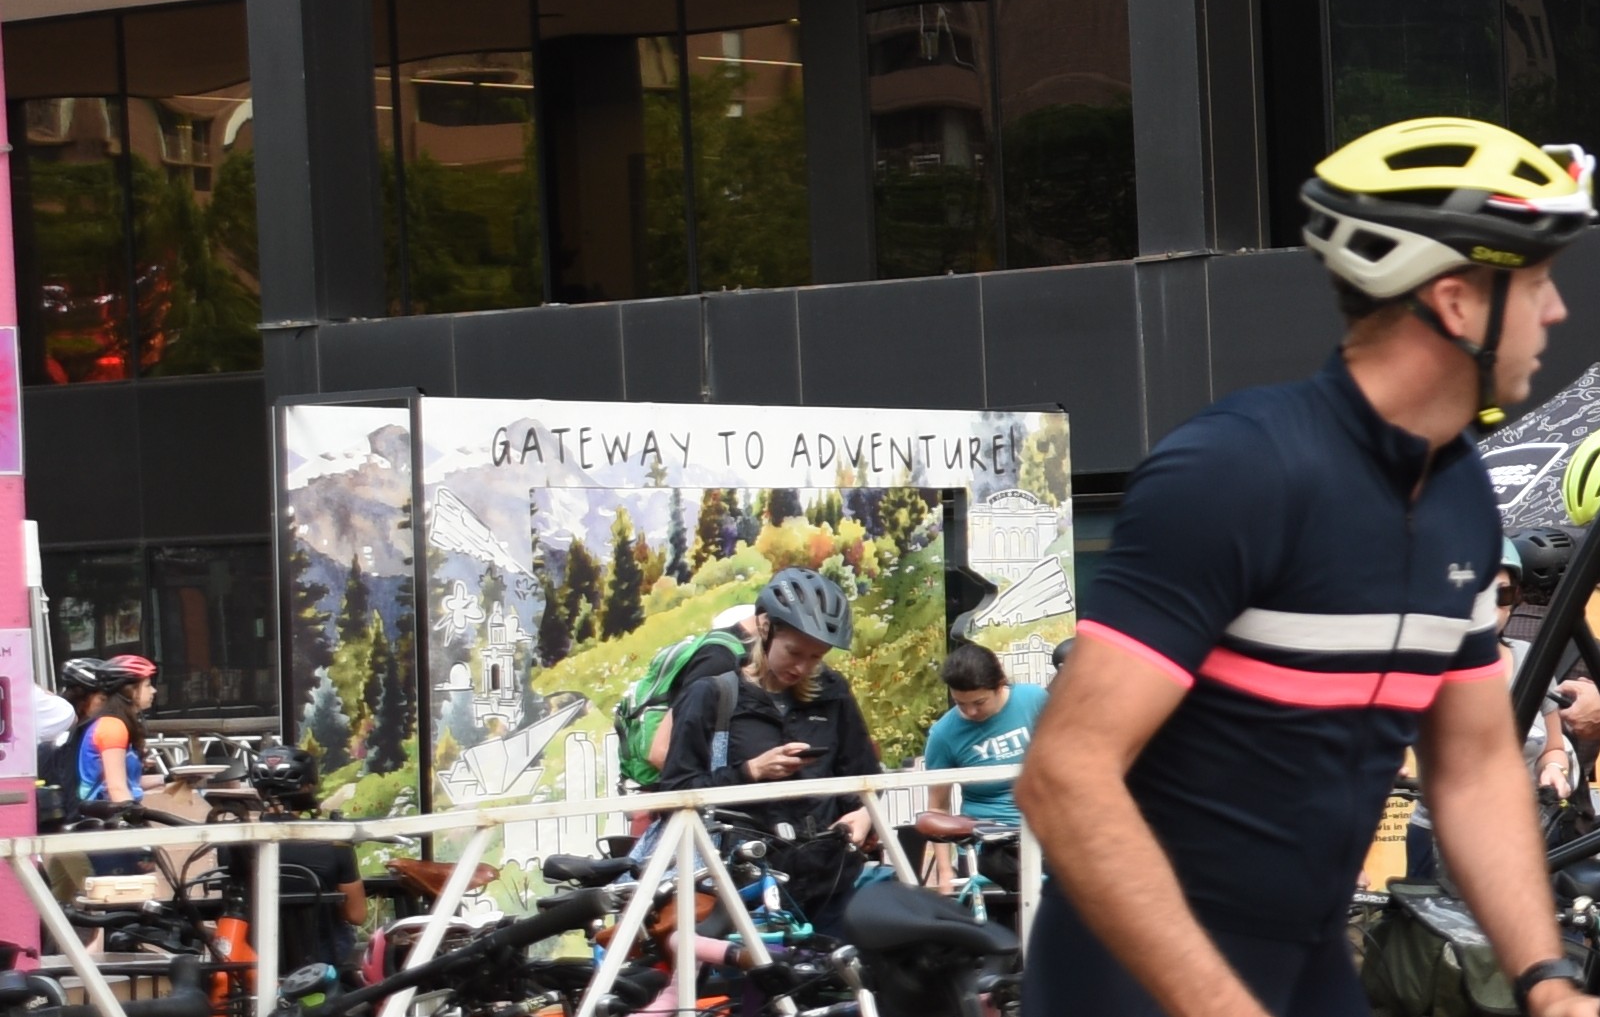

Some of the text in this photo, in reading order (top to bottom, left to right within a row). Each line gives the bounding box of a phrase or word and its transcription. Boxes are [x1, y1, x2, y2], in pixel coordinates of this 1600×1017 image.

[1470, 244, 1525, 267] SMITH
[492, 426, 1018, 475] GATEWAY TO ADVENTURE!
[973, 726, 1031, 759] YETI
